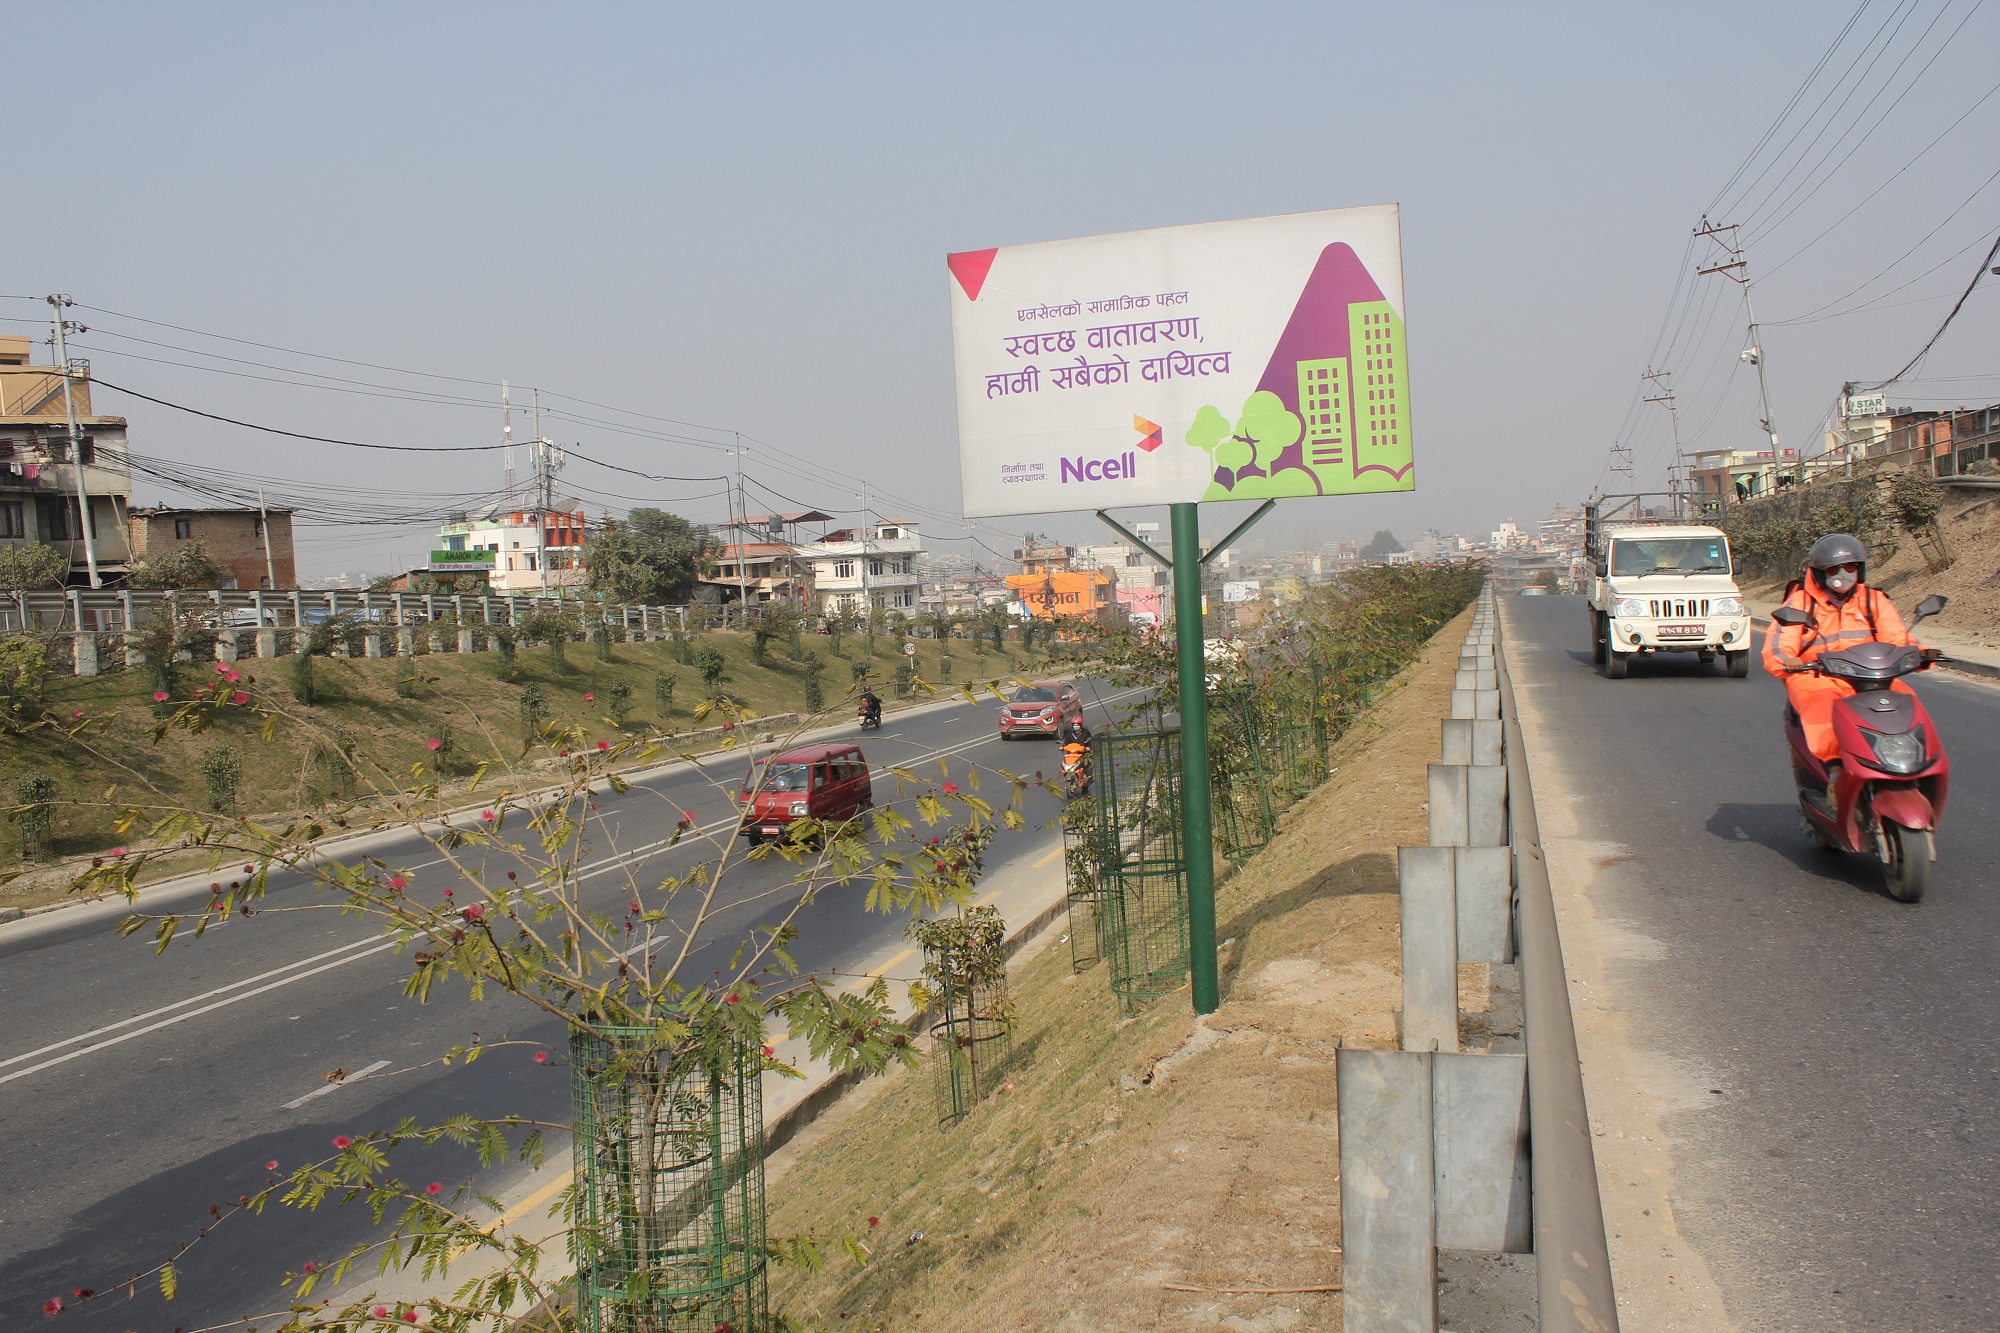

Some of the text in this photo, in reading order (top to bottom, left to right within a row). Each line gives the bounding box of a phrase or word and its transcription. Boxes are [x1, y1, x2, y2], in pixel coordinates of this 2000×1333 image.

[1017, 291, 1189, 322] एनसेलको सामाजिक पहल
[1003, 317, 1205, 358] स्वच्छ वातावरण,
[985, 350, 1233, 400] हामी सबैको दायित्व
[1856, 398, 1883, 409] STAR
[1850, 407, 1884, 415] HOSPITAL
[1001, 462, 1045, 474] निर्माण तथा
[1060, 451, 1136, 484] Ncell
[444, 552, 472, 560] AMARON
[905, 645, 915, 653] 50
